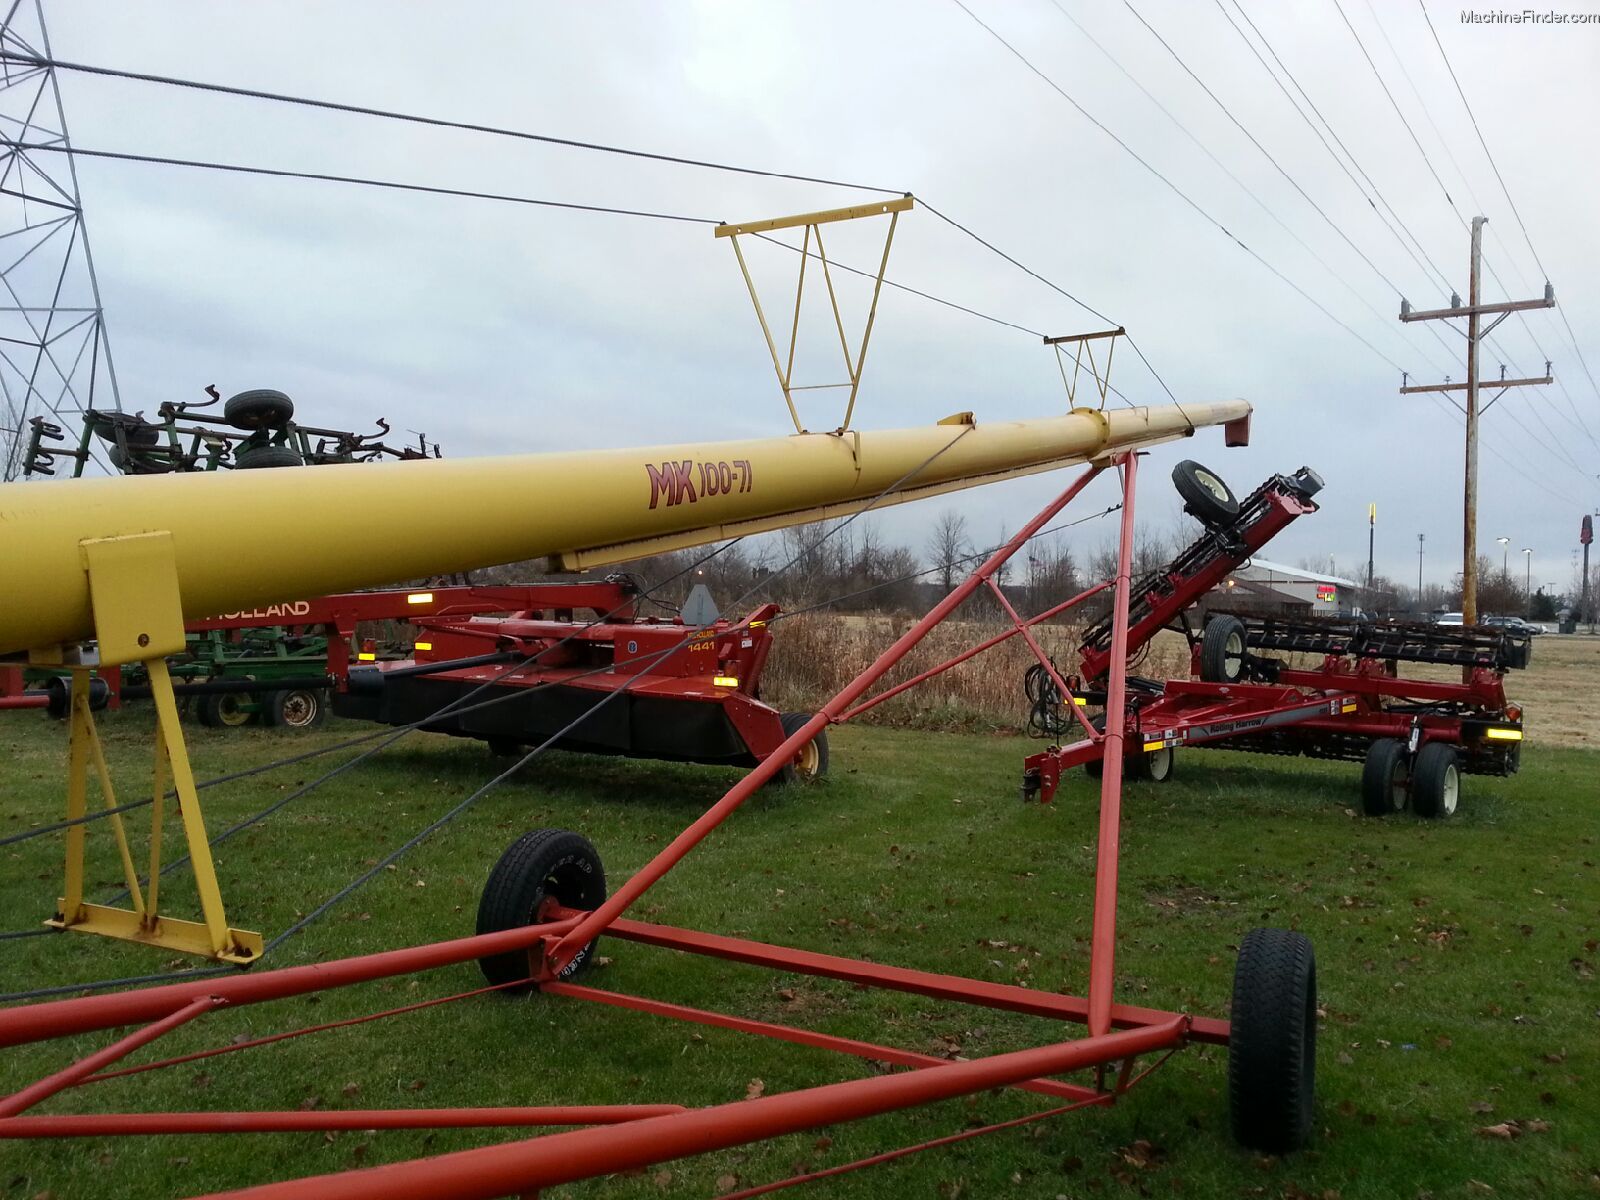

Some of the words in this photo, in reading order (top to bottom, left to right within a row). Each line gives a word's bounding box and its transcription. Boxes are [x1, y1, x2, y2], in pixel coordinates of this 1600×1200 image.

[645, 460, 697, 510] MK
[698, 460, 753, 497] 100-71
[206, 600, 310, 621] LLAND
[687, 641, 715, 652] 1441
[1210, 722, 1234, 734] Rolling
[1235, 719, 1262, 729] Harrow
